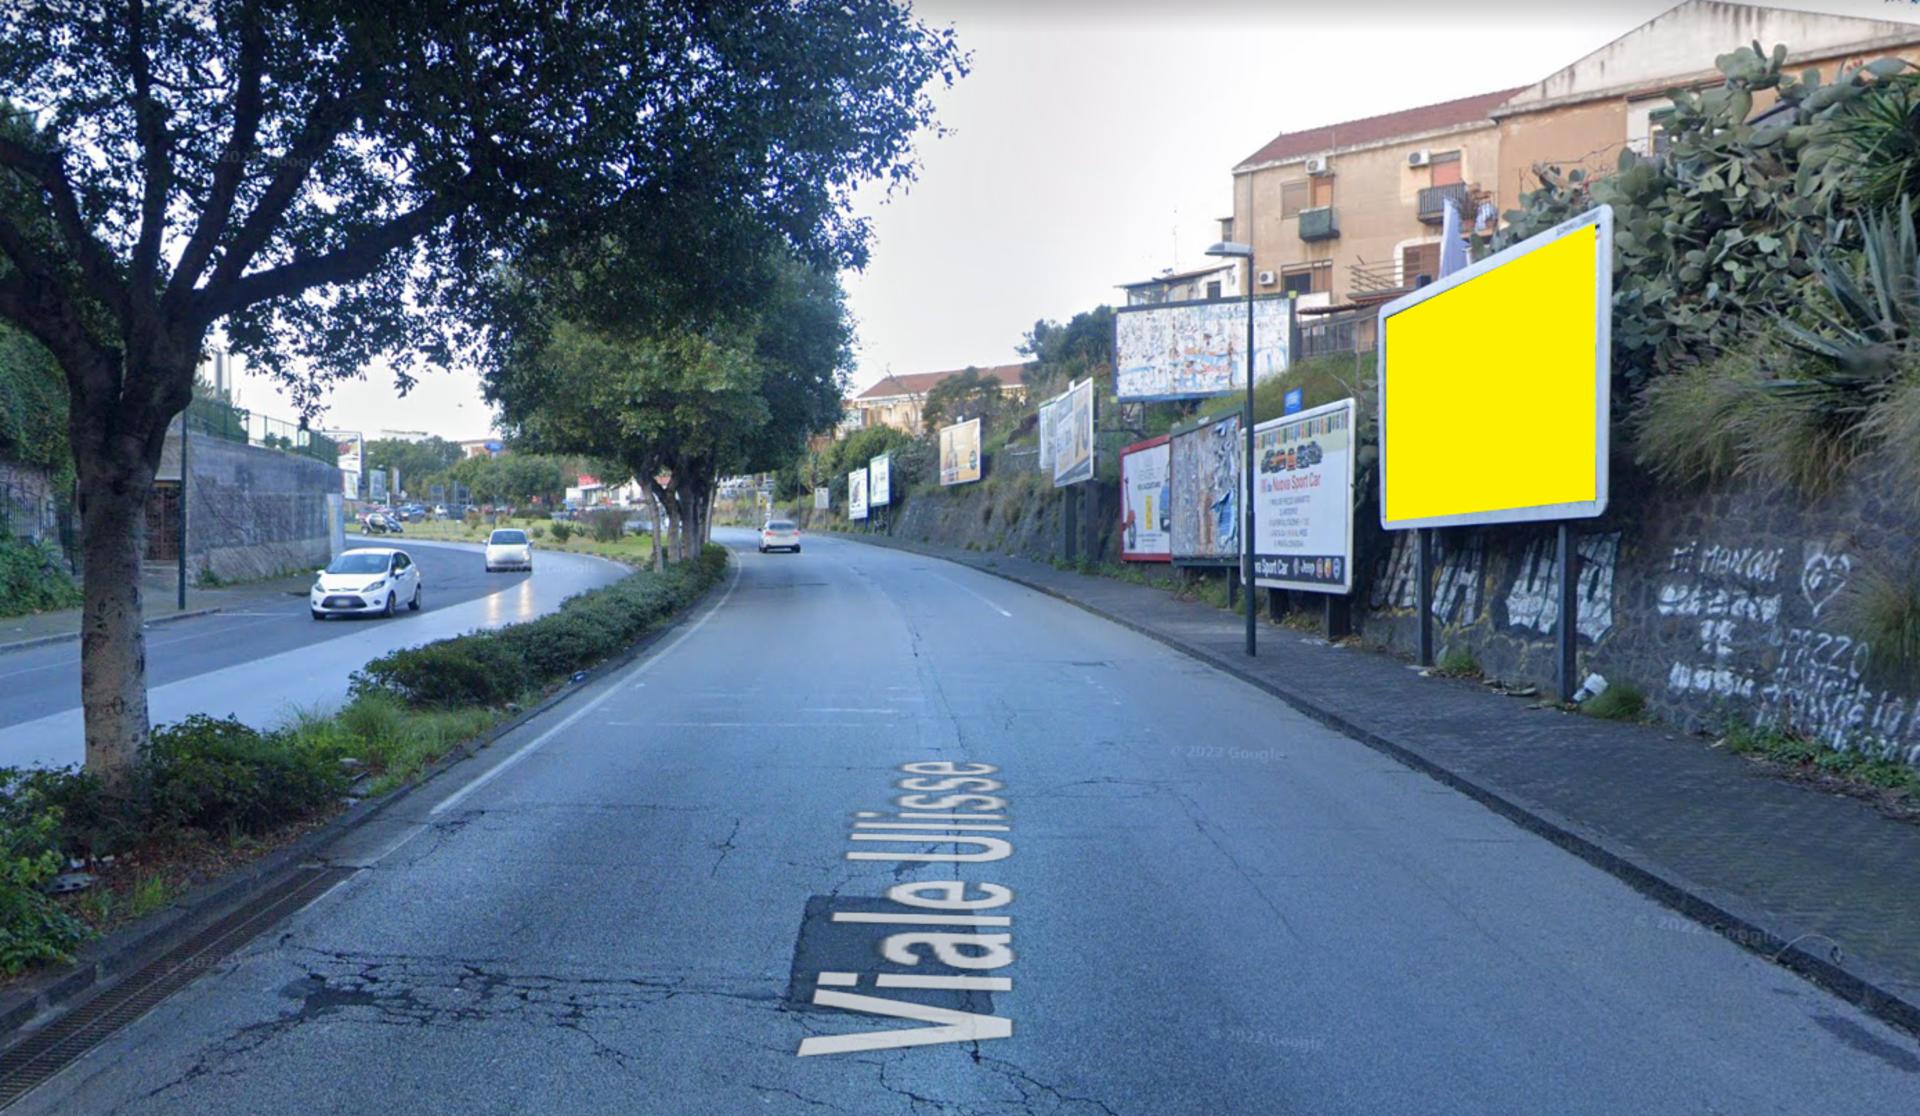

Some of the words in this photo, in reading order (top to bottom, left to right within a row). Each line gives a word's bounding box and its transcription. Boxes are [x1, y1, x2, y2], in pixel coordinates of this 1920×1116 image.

[1273, 476, 1291, 491] Nuova
[1291, 474, 1309, 492] Sport
[1310, 472, 1321, 487] Car
[1261, 558, 1277, 577] Sport
[1277, 558, 1288, 575] Car
[1301, 560, 1315, 576] Jeep
